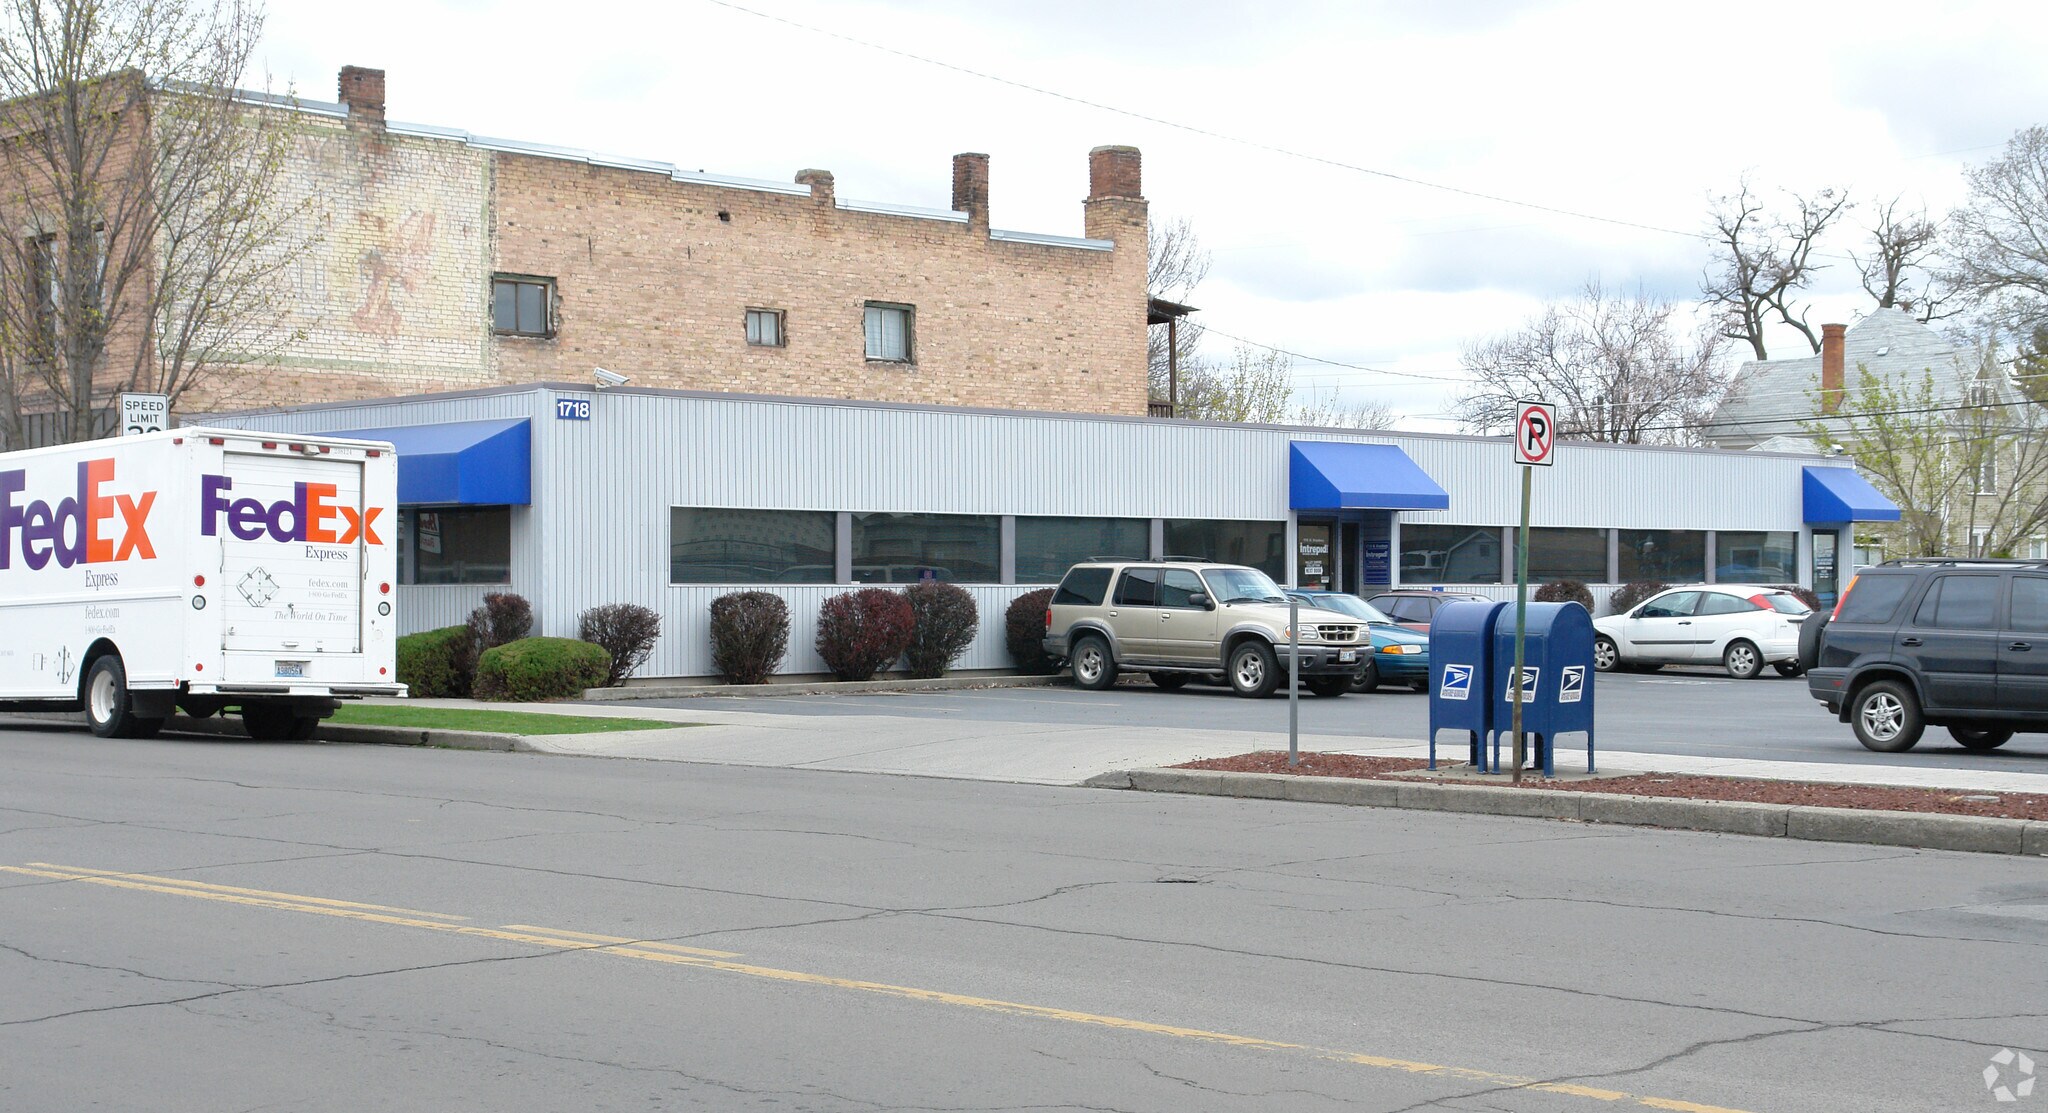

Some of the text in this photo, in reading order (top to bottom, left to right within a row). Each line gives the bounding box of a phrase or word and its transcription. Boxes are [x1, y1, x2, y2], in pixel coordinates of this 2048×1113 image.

[125, 400, 164, 411] SPEED
[557, 401, 589, 418] 1718
[130, 413, 159, 423] LIMIT
[1527, 417, 1546, 451] P
[0, 457, 158, 571] FedEx
[201, 473, 385, 546] FedEx
[305, 545, 348, 561] Express
[85, 569, 119, 591] Express
[308, 578, 348, 589] fedex.com
[85, 604, 120, 619] fedex.com
[274, 610, 348, 622] The World On Time
